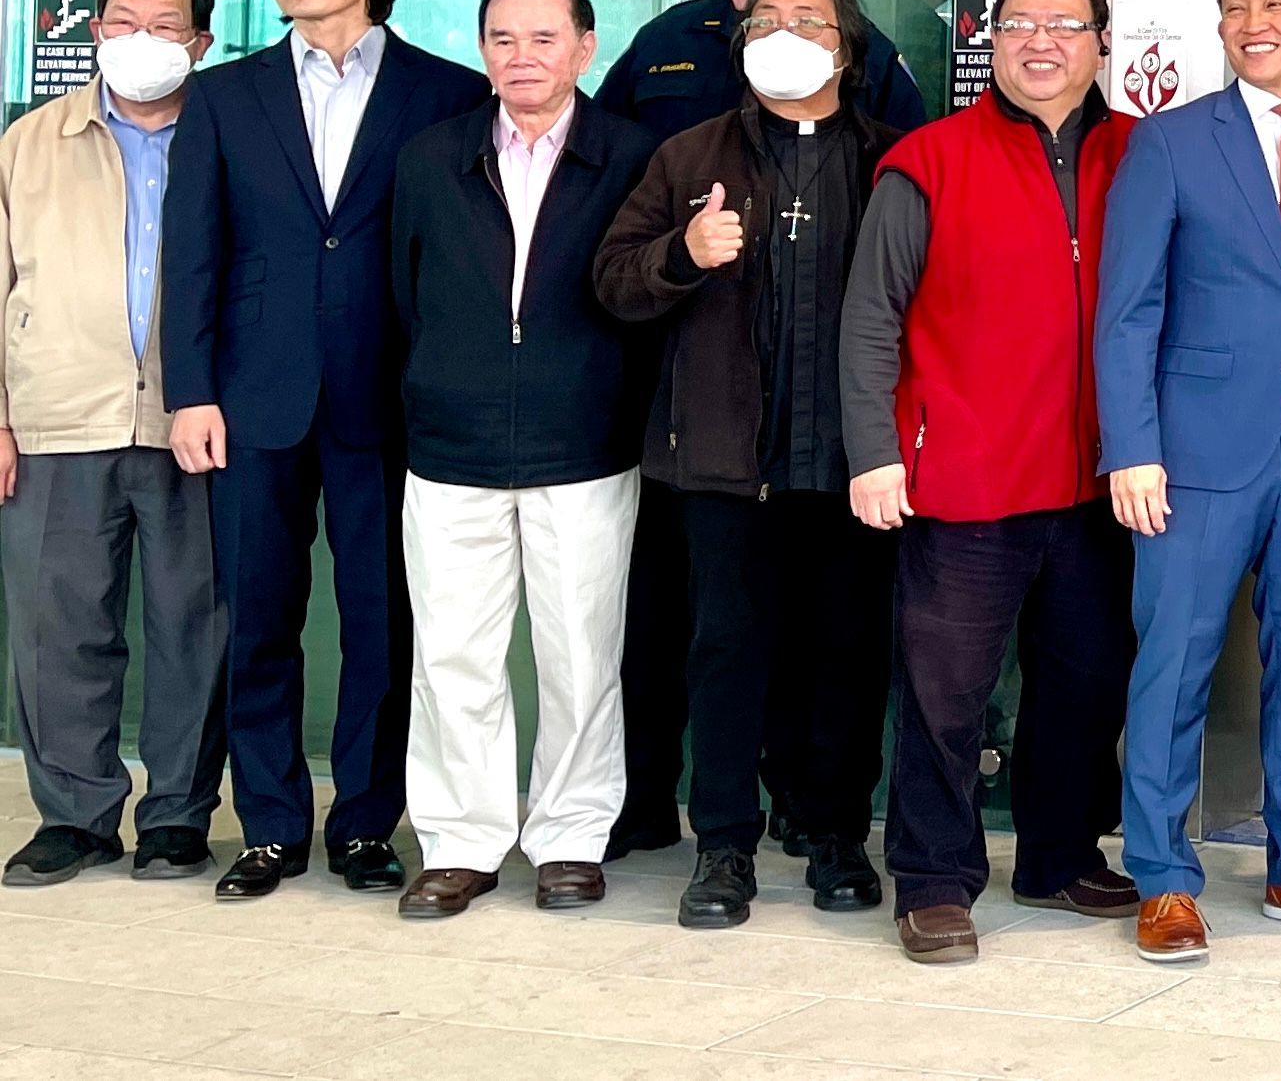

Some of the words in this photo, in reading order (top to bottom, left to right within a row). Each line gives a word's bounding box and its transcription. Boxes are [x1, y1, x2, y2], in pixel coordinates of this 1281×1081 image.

[36, 47, 46, 57] IN
[46, 47, 65, 57] CASE
[66, 47, 76, 57] OF
[76, 47, 92, 57] FIRE
[36, 59, 77, 70] ELEVATORS
[78, 59, 92, 70] ARE
[956, 54, 966, 65] IN
[967, 54, 990, 65] CASE
[35, 72, 50, 82] OUT
[50, 72, 60, 82] OF
[61, 72, 91, 82] SERVICE
[956, 68, 992, 79] ELEVATO
[33, 85, 48, 95] USE
[49, 85, 66, 95] EXIT
[954, 82, 972, 93] OUT
[973, 82, 985, 93] OF
[953, 96, 971, 107] USE
